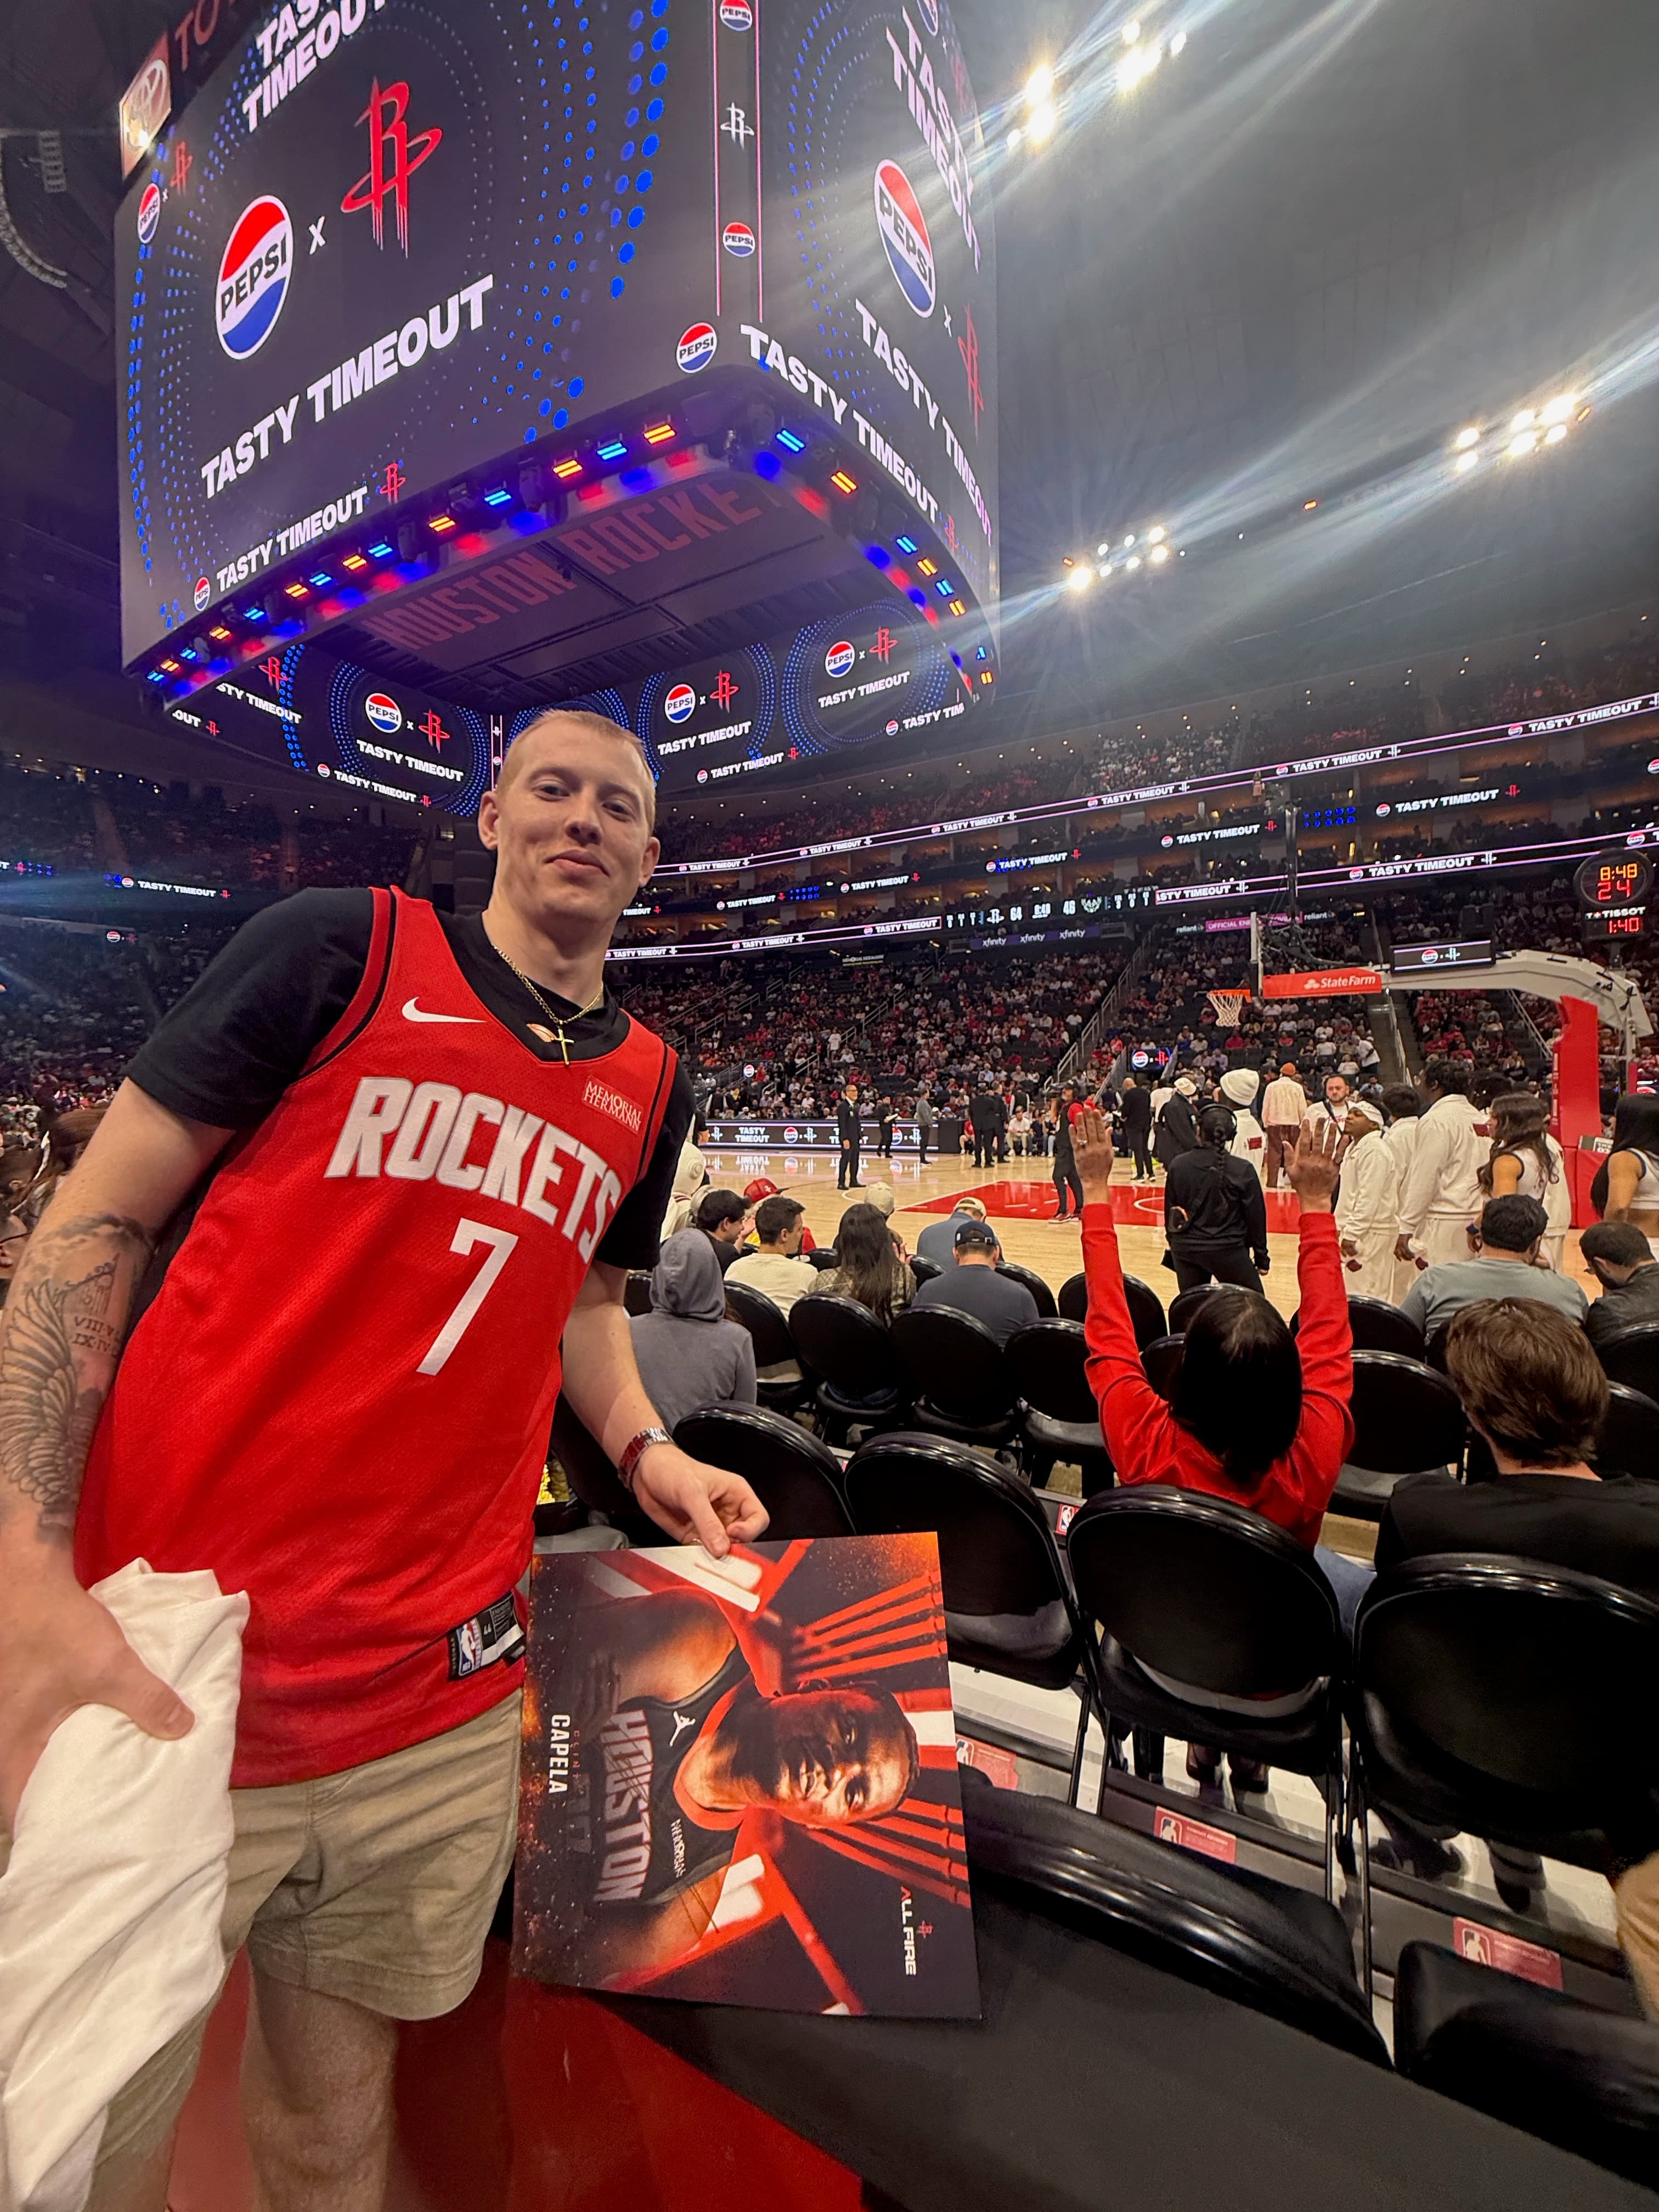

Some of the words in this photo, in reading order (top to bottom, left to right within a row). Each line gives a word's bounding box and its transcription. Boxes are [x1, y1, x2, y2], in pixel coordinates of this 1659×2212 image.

[721, 7, 751, 20] PEPSI
[242, 0, 386, 133] TIMEOU
[902, 5, 973, 208] TASTY
[887, 27, 980, 274] TIMEOUT
[724, 233, 754, 246] PEPSI
[879, 187, 933, 289] PEPSI
[221, 241, 289, 320] PEPSI
[201, 395, 298, 499] TASTY
[307, 274, 493, 423] TIMEOUT
[679, 337, 714, 360] PEPSI
[741, 324, 847, 425] TASTY
[853, 409, 938, 524] TIMEOUT
[856, 299, 939, 430] TASTY
[942, 416, 992, 547] TIMEOUT
[217, 540, 273, 591] TASTY
[276, 486, 368, 556] TIMEOUT
[361, 551, 577, 651] HOUSTON
[827, 653, 853, 667] PEPSI
[817, 688, 856, 708] TASTY
[857, 672, 910, 698] TIMEOUT
[246, 691, 302, 724] TIMEOUT
[368, 704, 399, 722] PEPSI
[667, 697, 693, 710] PEPSI
[902, 710, 941, 730] TASTY
[1529, 715, 1575, 732] TASTY
[1577, 699, 1642, 723] TIMEOUT
[657, 736, 697, 757] TASTY
[698, 721, 752, 744] TIMEOUT
[357, 740, 404, 768] TASTY
[405, 754, 464, 782] TIMEOUT
[710, 763, 742, 780] TASTY
[742, 752, 785, 772] TIMEOUT
[1293, 758, 1330, 772] TASTY
[1331, 749, 1383, 766] TIMEOUT
[334, 770, 371, 791] TASTY
[371, 780, 416, 803] TIMEOUT
[1102, 793, 1132, 804] TASTY
[1133, 786, 1175, 799] TIMEOUT
[1395, 798, 1438, 812] TASTY
[1440, 789, 1499, 806] TIMEOUT
[943, 822, 968, 832] TASTY
[969, 815, 1005, 827] TIMEOUT
[1177, 831, 1212, 844] TASTY
[1212, 824, 1260, 839] TIMEOUT
[809, 845, 831, 854] TASTY
[832, 839, 861, 850] TIMEOUT
[712, 861, 741, 869] TIMEOUT
[999, 858, 1028, 870] TASTY
[1028, 852, 1068, 865] TIMEOUT
[1368, 862, 1413, 877] TASTY
[1414, 856, 1475, 872] TIMEOUT
[851, 881, 876, 890] TASTY
[876, 875, 909, 887] TIMEOUT
[1600, 863, 1638, 881] 8:48
[138, 881, 172, 891] TASTY
[173, 885, 217, 898] TIMEOUT
[1183, 885, 1231, 898] TIMEOUT
[1598, 879, 1630, 901] 24
[726, 899, 748, 909] TASTY
[748, 895, 776, 905] TIMEOUT
[1601, 906, 1646, 919] TISSOT
[875, 924, 901, 933] TASTY
[902, 919, 938, 930] TIMEOUT
[1208, 921, 1238, 929] OFFICIAL
[1304, 912, 1327, 920] reliant
[1609, 917, 1640, 934] 1:40
[742, 940, 764, 949] TASTY
[764, 936, 794, 946] TIMEOUT
[982, 937, 1007, 947] xfinity
[1020, 933, 1045, 944] xfinity
[1059, 929, 1085, 939] xfinity
[583, 1092, 641, 1131] HERMANN
[585, 1081, 641, 1122] MEMORIAL
[735, 1135, 770, 1143] TIMEOUT
[738, 1127, 766, 1135] TASTY
[324, 1076, 622, 1265] ROCKETS
[415, 1217, 519, 1376] 7
[549, 1713, 571, 1795] CAPELA
[594, 1708, 654, 1901] HOUSTON
[900, 1886, 913, 1925] ALL
[904, 1926, 917, 1976] FIRE
